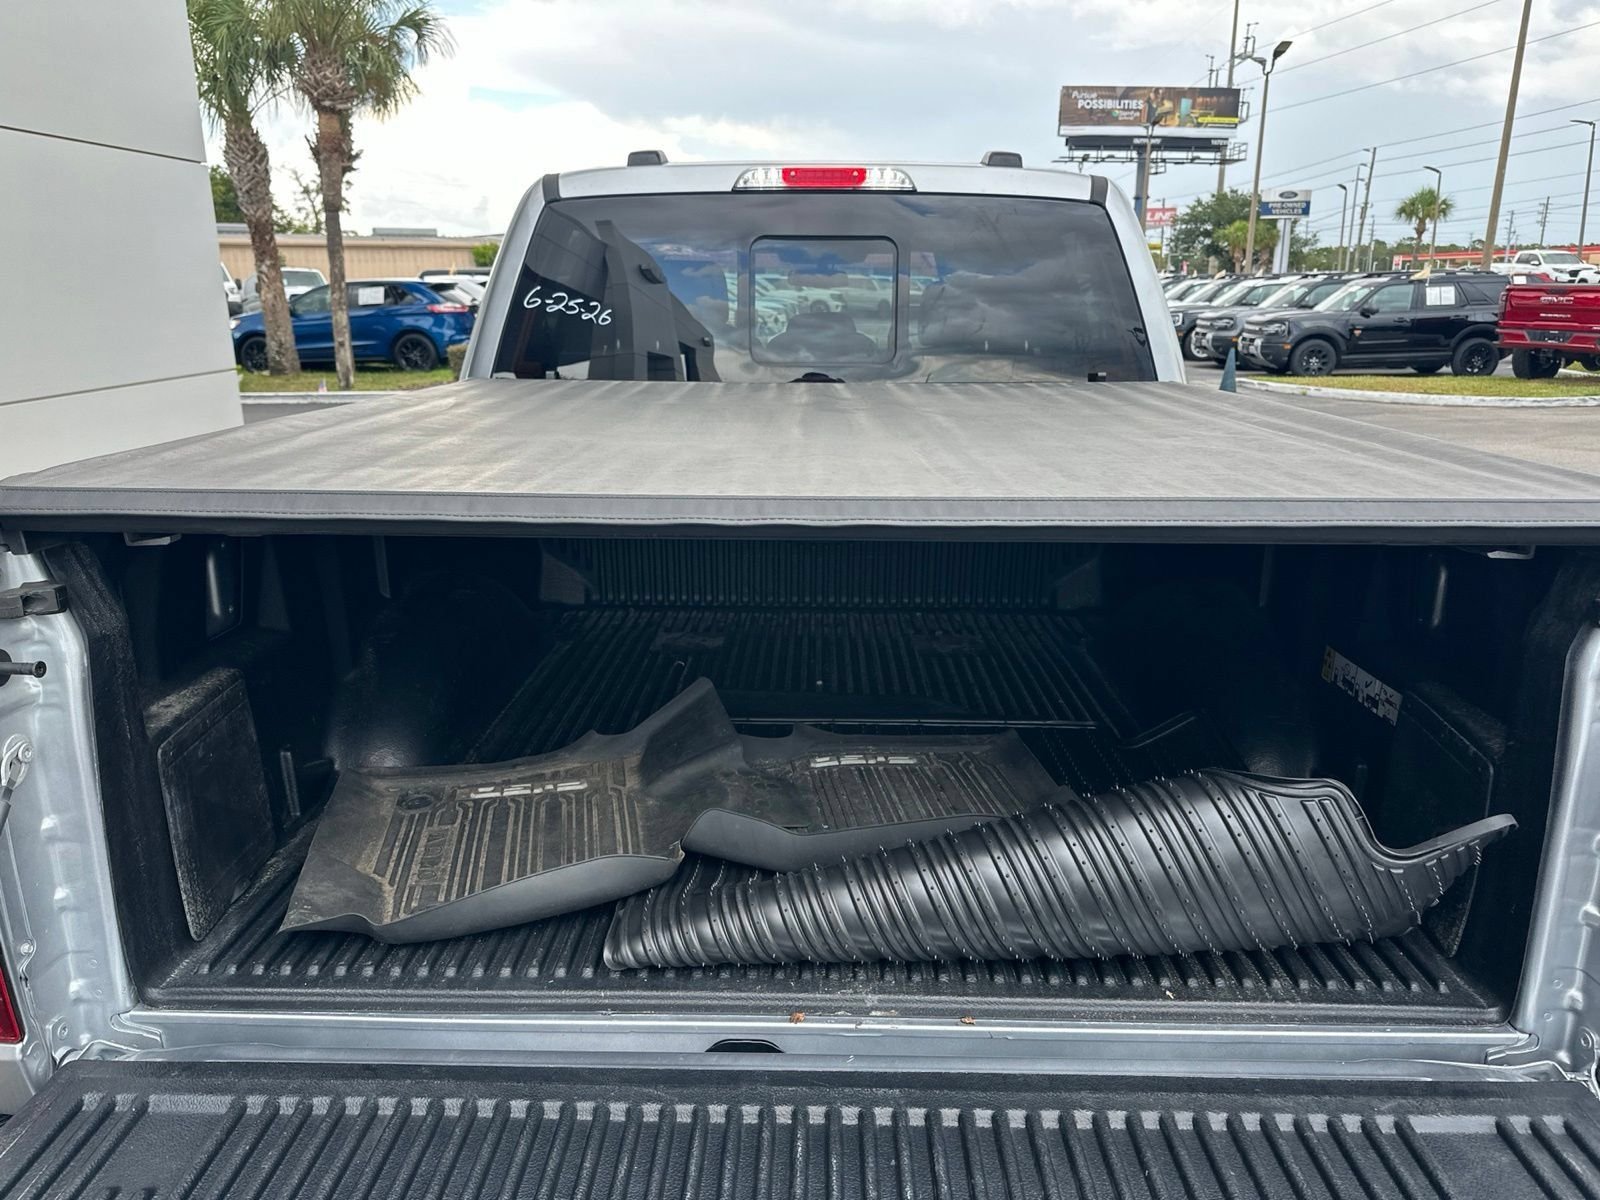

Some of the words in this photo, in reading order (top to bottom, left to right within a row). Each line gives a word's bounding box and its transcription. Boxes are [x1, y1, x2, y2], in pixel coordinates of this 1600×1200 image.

[1077, 99, 1144, 110] POSSIBILITIES
[523, 286, 612, 325] 6-25-26
[1540, 296, 1575, 304] GMC
